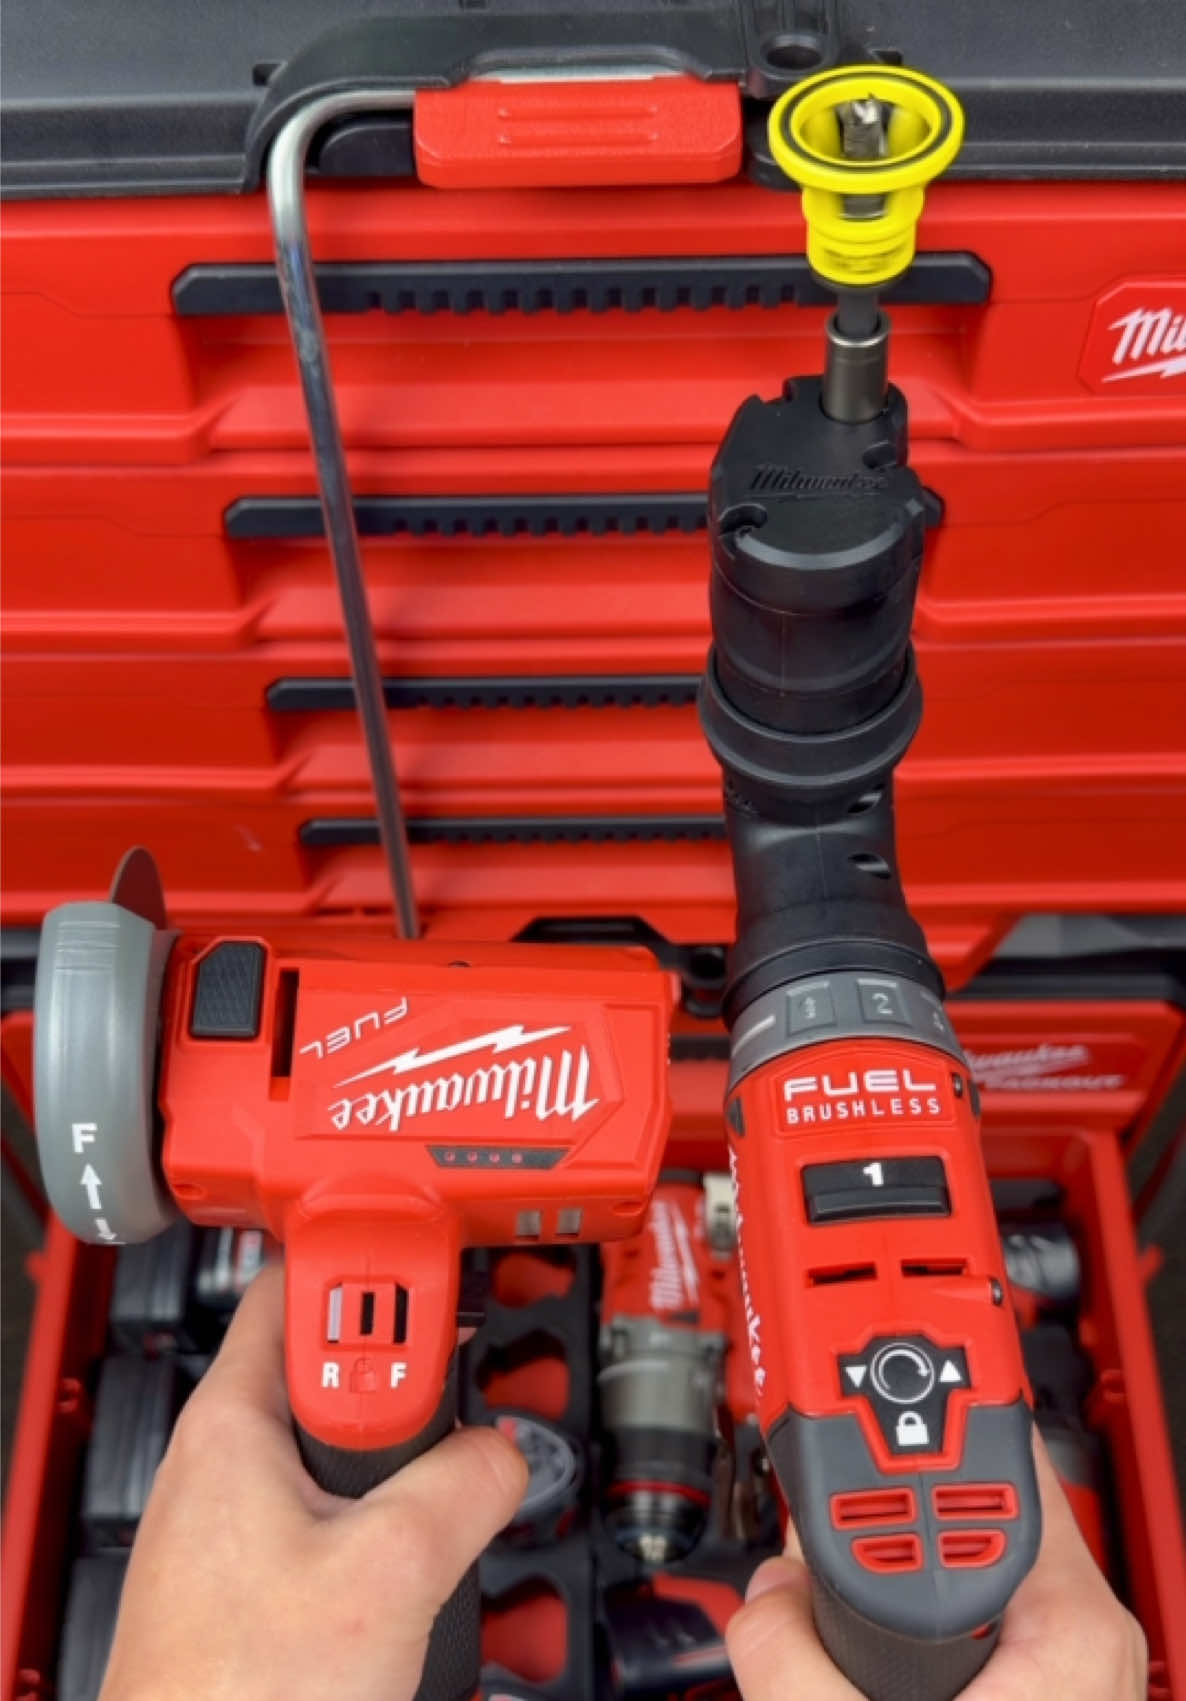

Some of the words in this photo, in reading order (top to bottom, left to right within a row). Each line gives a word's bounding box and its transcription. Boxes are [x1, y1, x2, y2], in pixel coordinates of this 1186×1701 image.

[872, 992, 893, 1015] 2
[299, 996, 408, 1059] FUEL
[327, 1045, 600, 1132] Milwaukee
[784, 1068, 937, 1102] FUEL
[786, 1098, 941, 1125] BRUSHLESS
[71, 1122, 98, 1153] F
[863, 1162, 884, 1187] 1
[322, 1361, 340, 1388] R
[390, 1361, 407, 1388] F
